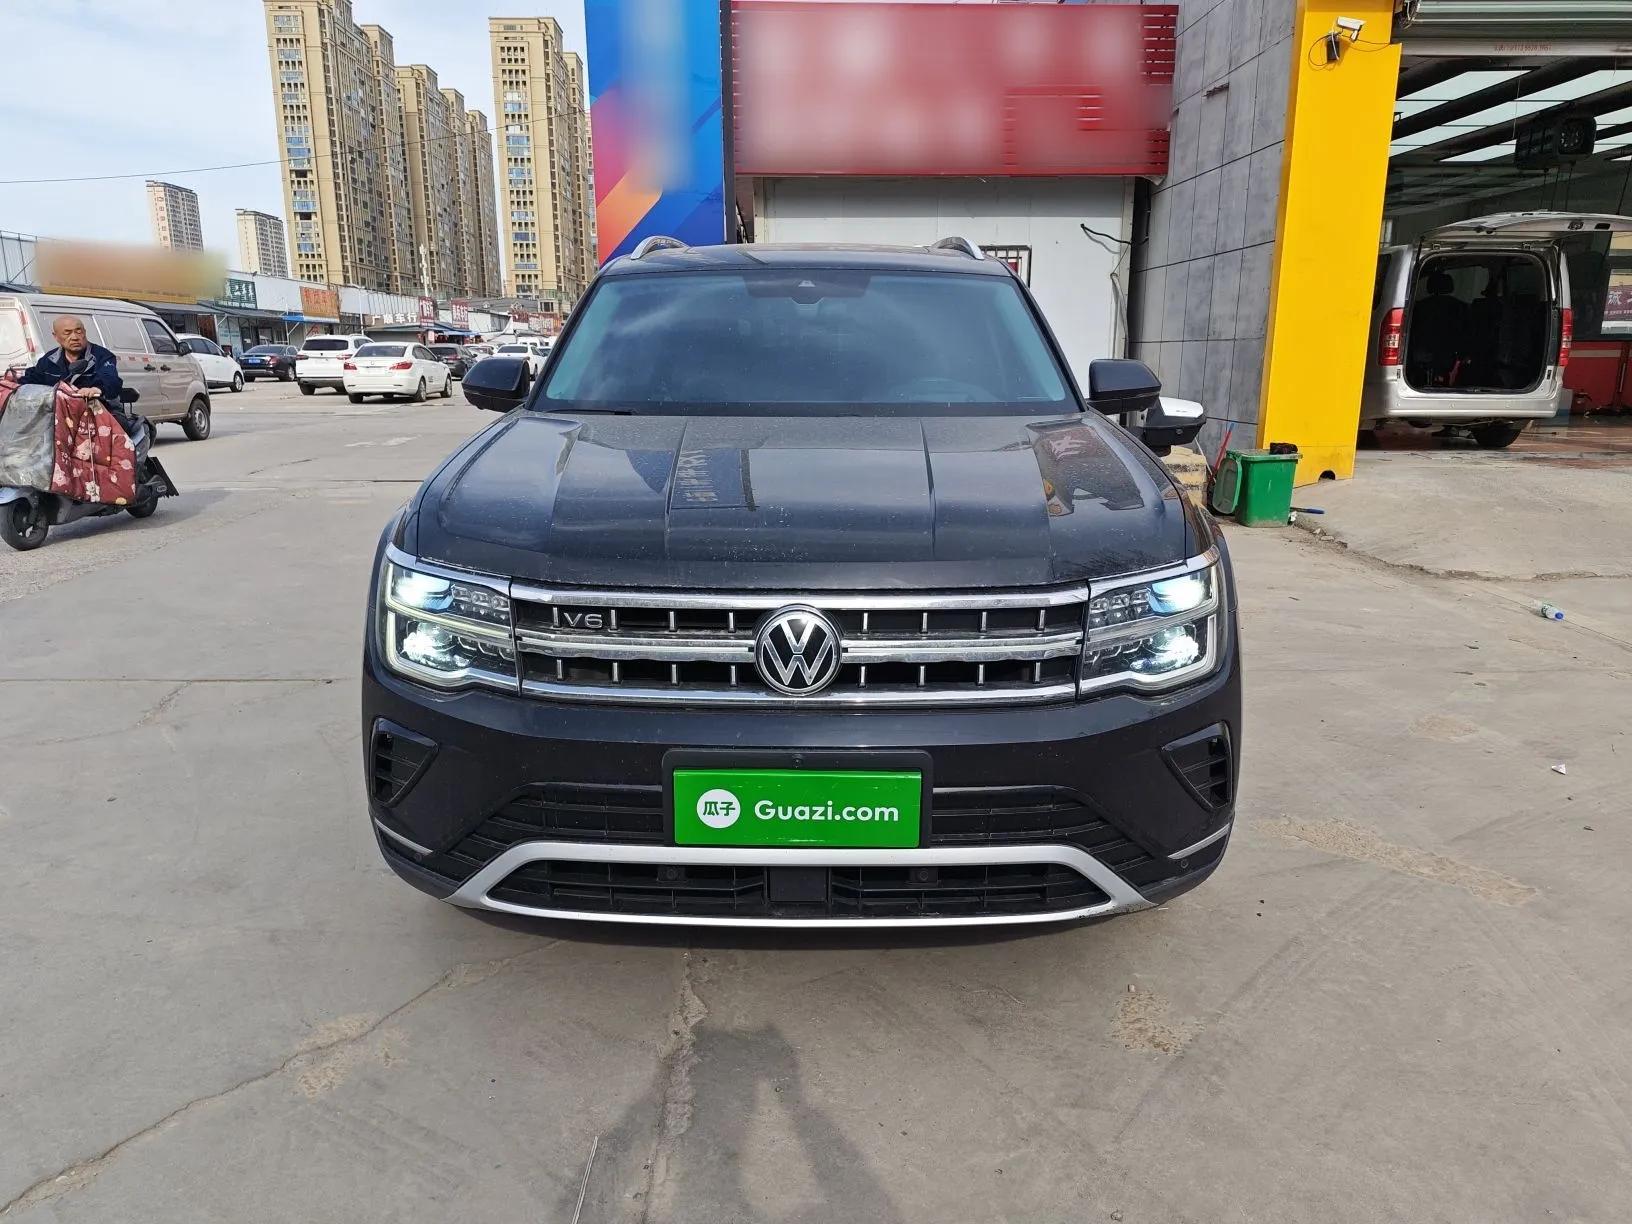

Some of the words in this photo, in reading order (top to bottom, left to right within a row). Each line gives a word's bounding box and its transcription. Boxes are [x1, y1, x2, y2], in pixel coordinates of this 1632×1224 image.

[563, 612, 603, 629] V6
[702, 800, 736, 817] 瓜子
[754, 799, 900, 821] Guazi.com
